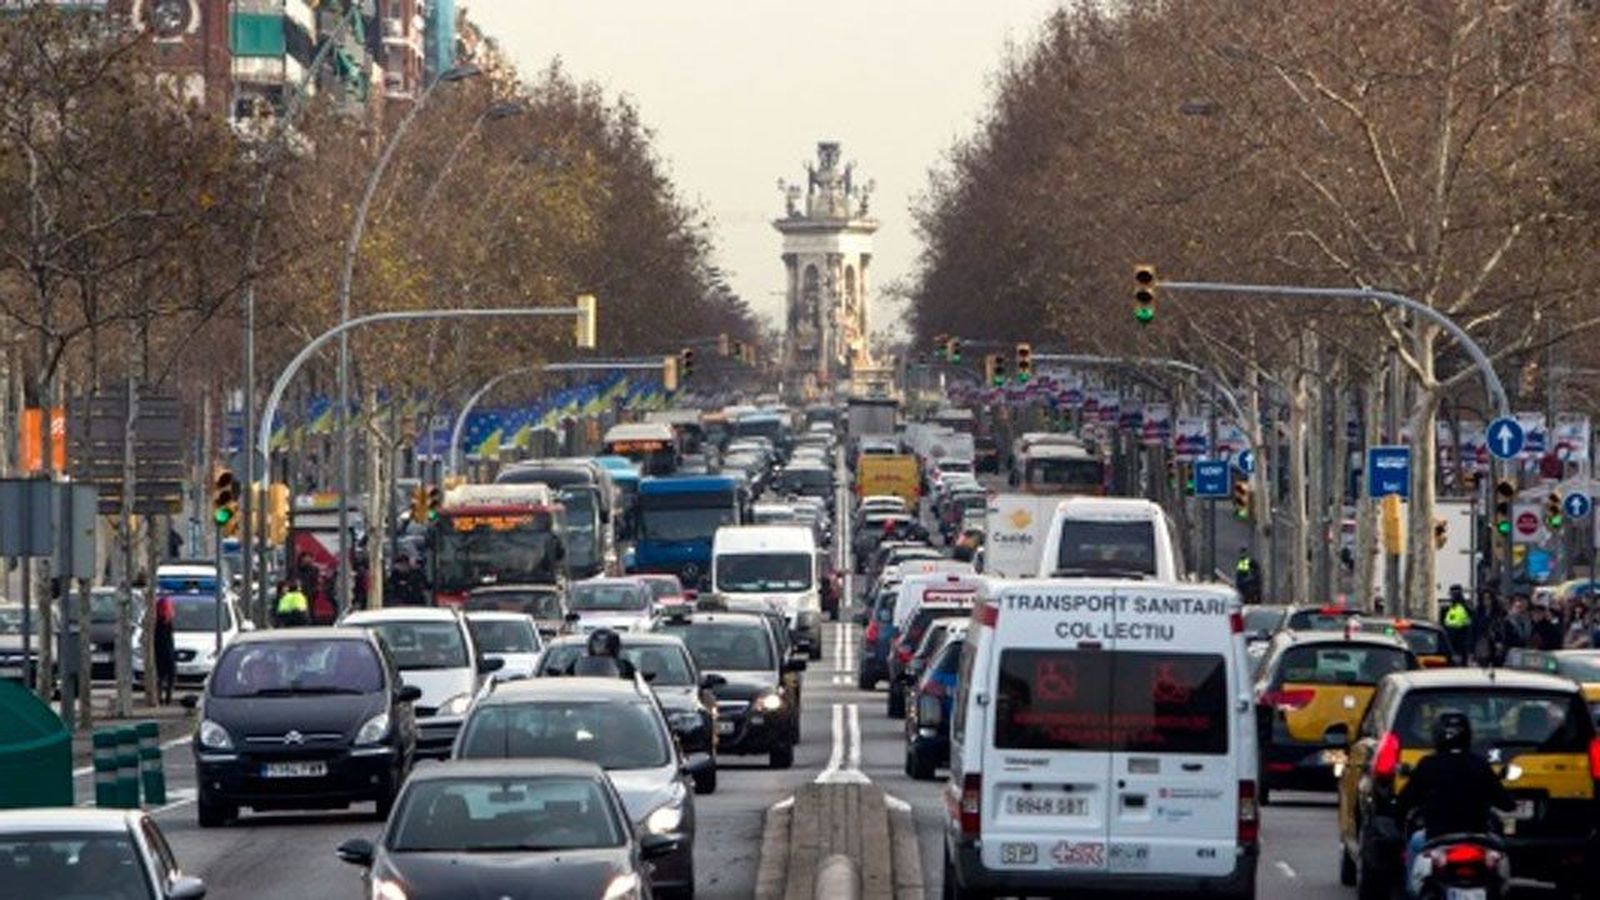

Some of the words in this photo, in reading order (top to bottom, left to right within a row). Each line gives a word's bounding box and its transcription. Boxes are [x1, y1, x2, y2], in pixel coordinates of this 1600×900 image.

[1006, 595, 1127, 612] TRANSPORT
[1133, 599, 1226, 615] SANITARI
[1054, 622, 1175, 641] COL·LECTIU
